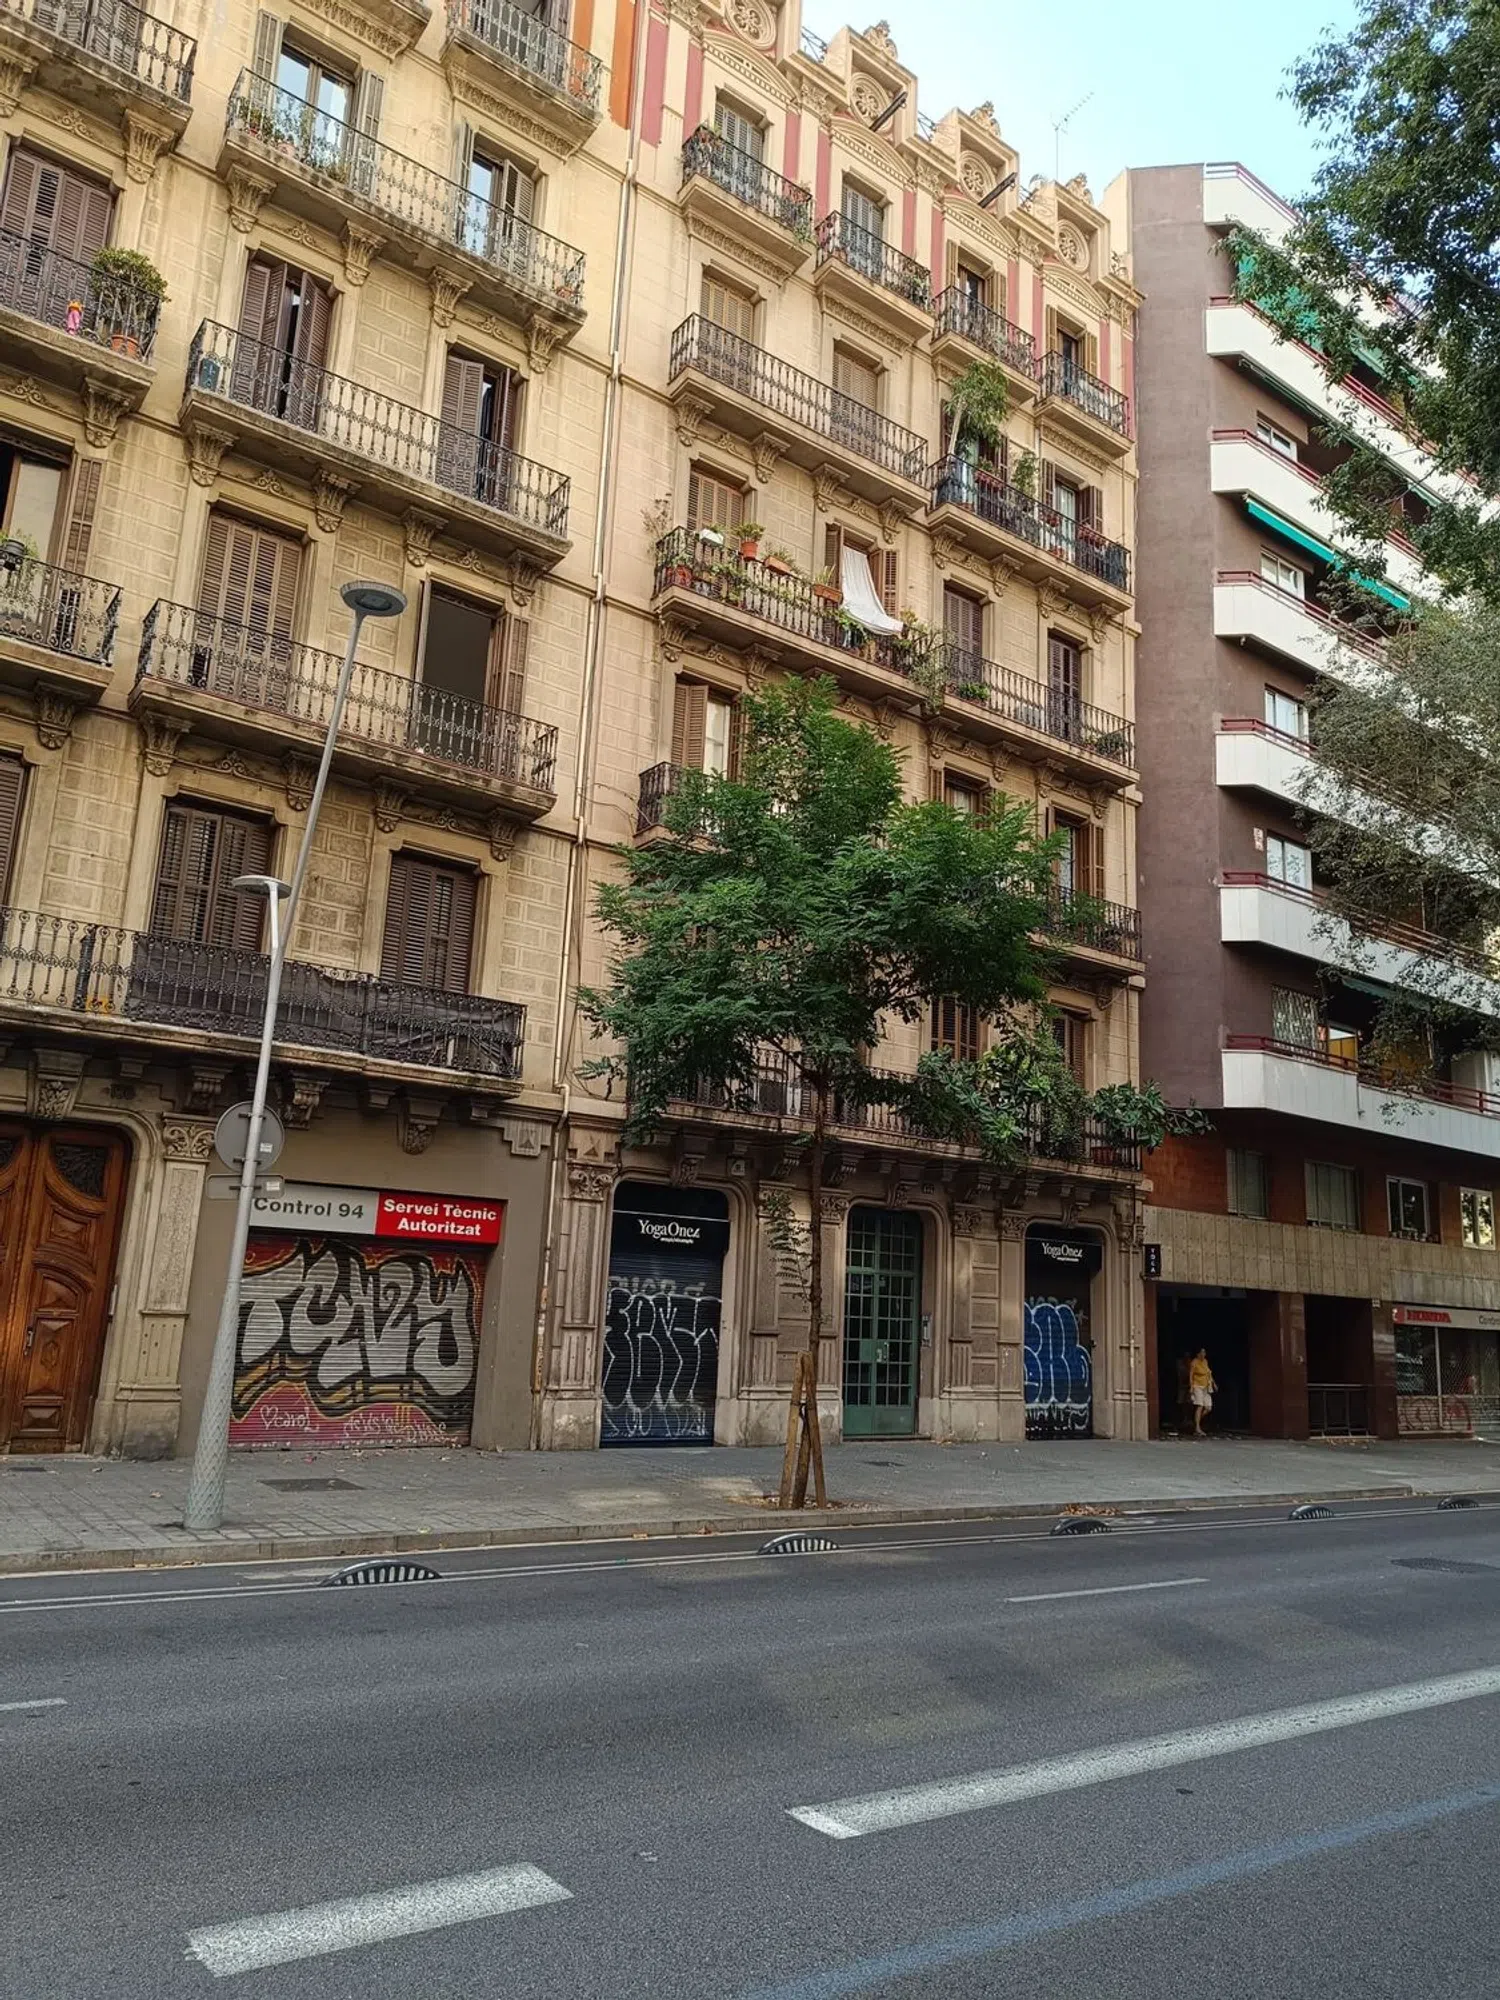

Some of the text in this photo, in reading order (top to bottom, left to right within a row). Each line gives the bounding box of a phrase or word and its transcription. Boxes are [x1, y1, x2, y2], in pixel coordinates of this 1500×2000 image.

[254, 1197, 364, 1219] Control 94
[383, 1198, 498, 1221] Servei Tècnic
[397, 1217, 482, 1236] Autoritzat
